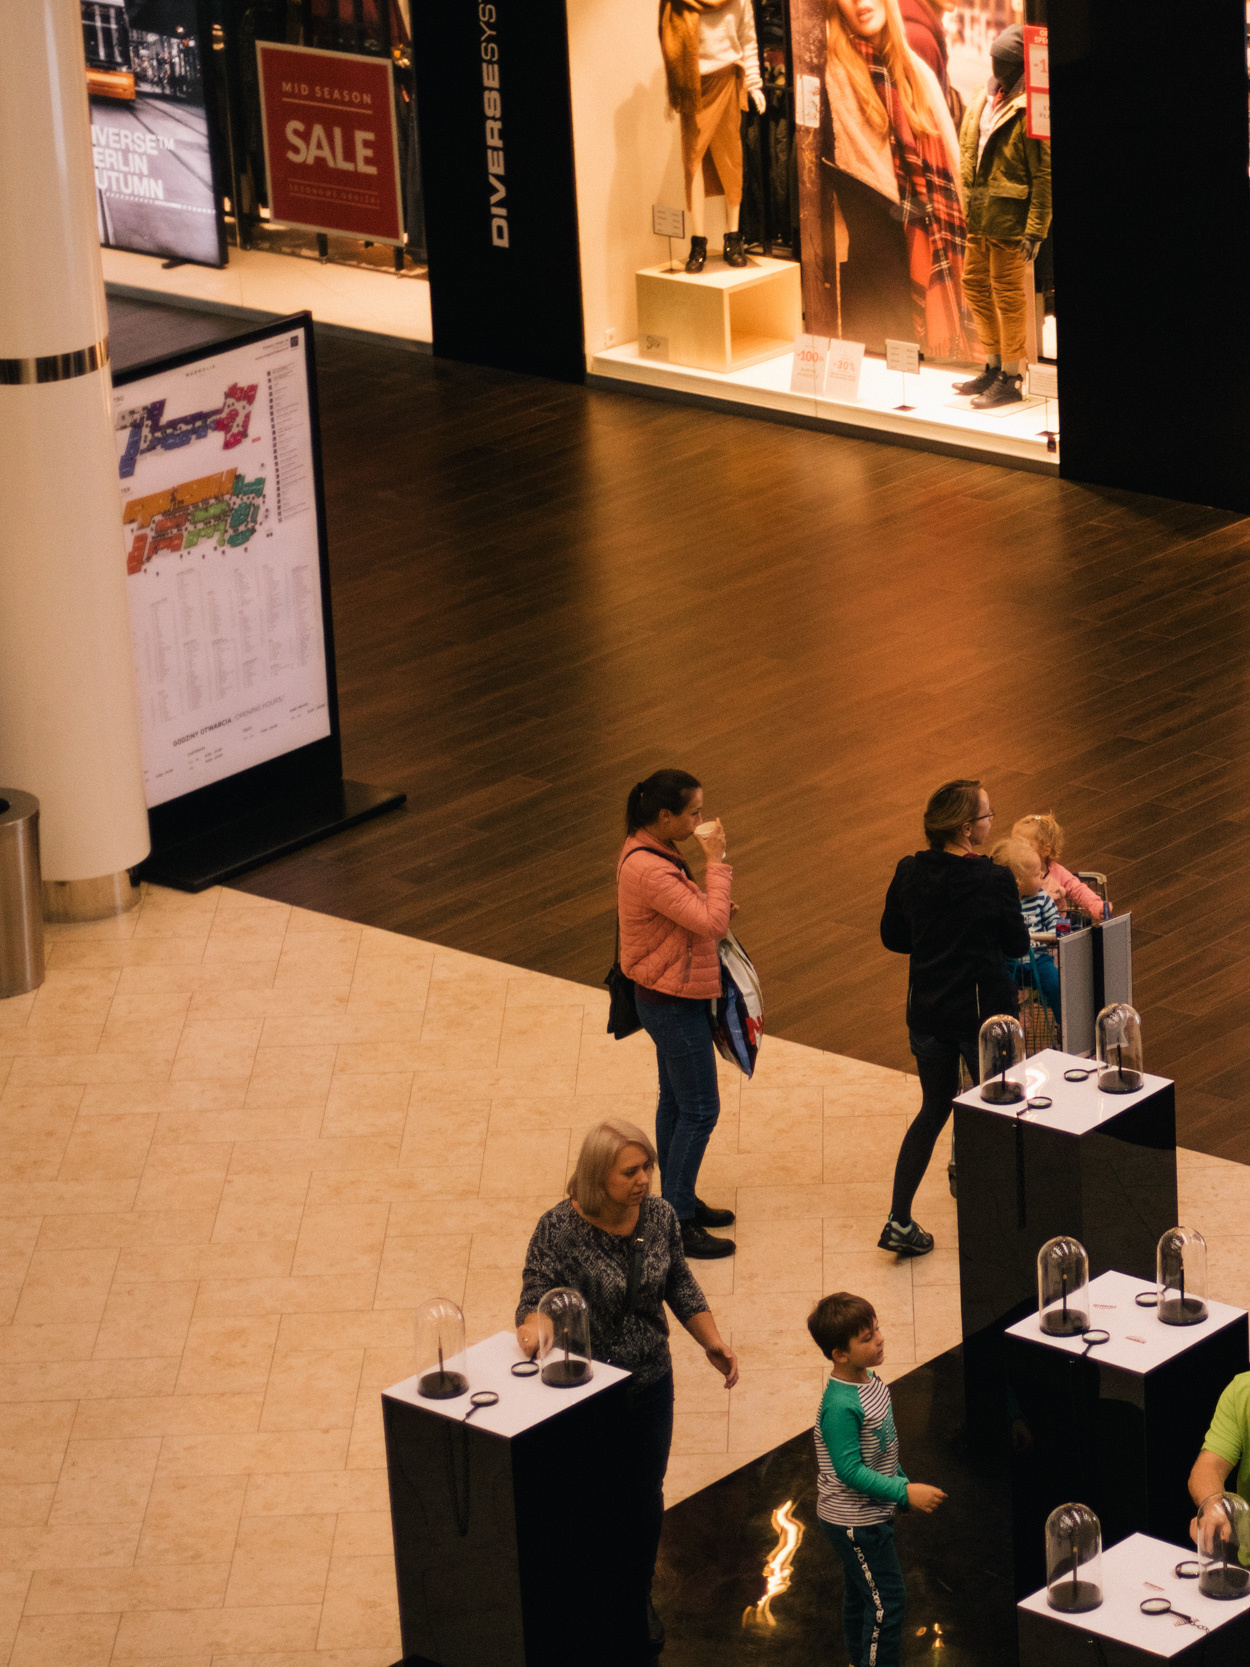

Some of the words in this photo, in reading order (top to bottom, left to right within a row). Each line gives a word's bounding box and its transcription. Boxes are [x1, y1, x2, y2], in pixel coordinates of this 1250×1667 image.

[282, 81, 309, 95] MID
[315, 86, 372, 105] SEASON
[478, 0, 509, 248] DIVERSESYS
[91, 124, 174, 156] IVERSE™
[285, 120, 378, 175] SALE
[93, 147, 148, 176] ERLIN
[95, 169, 164, 200] UTUMN
